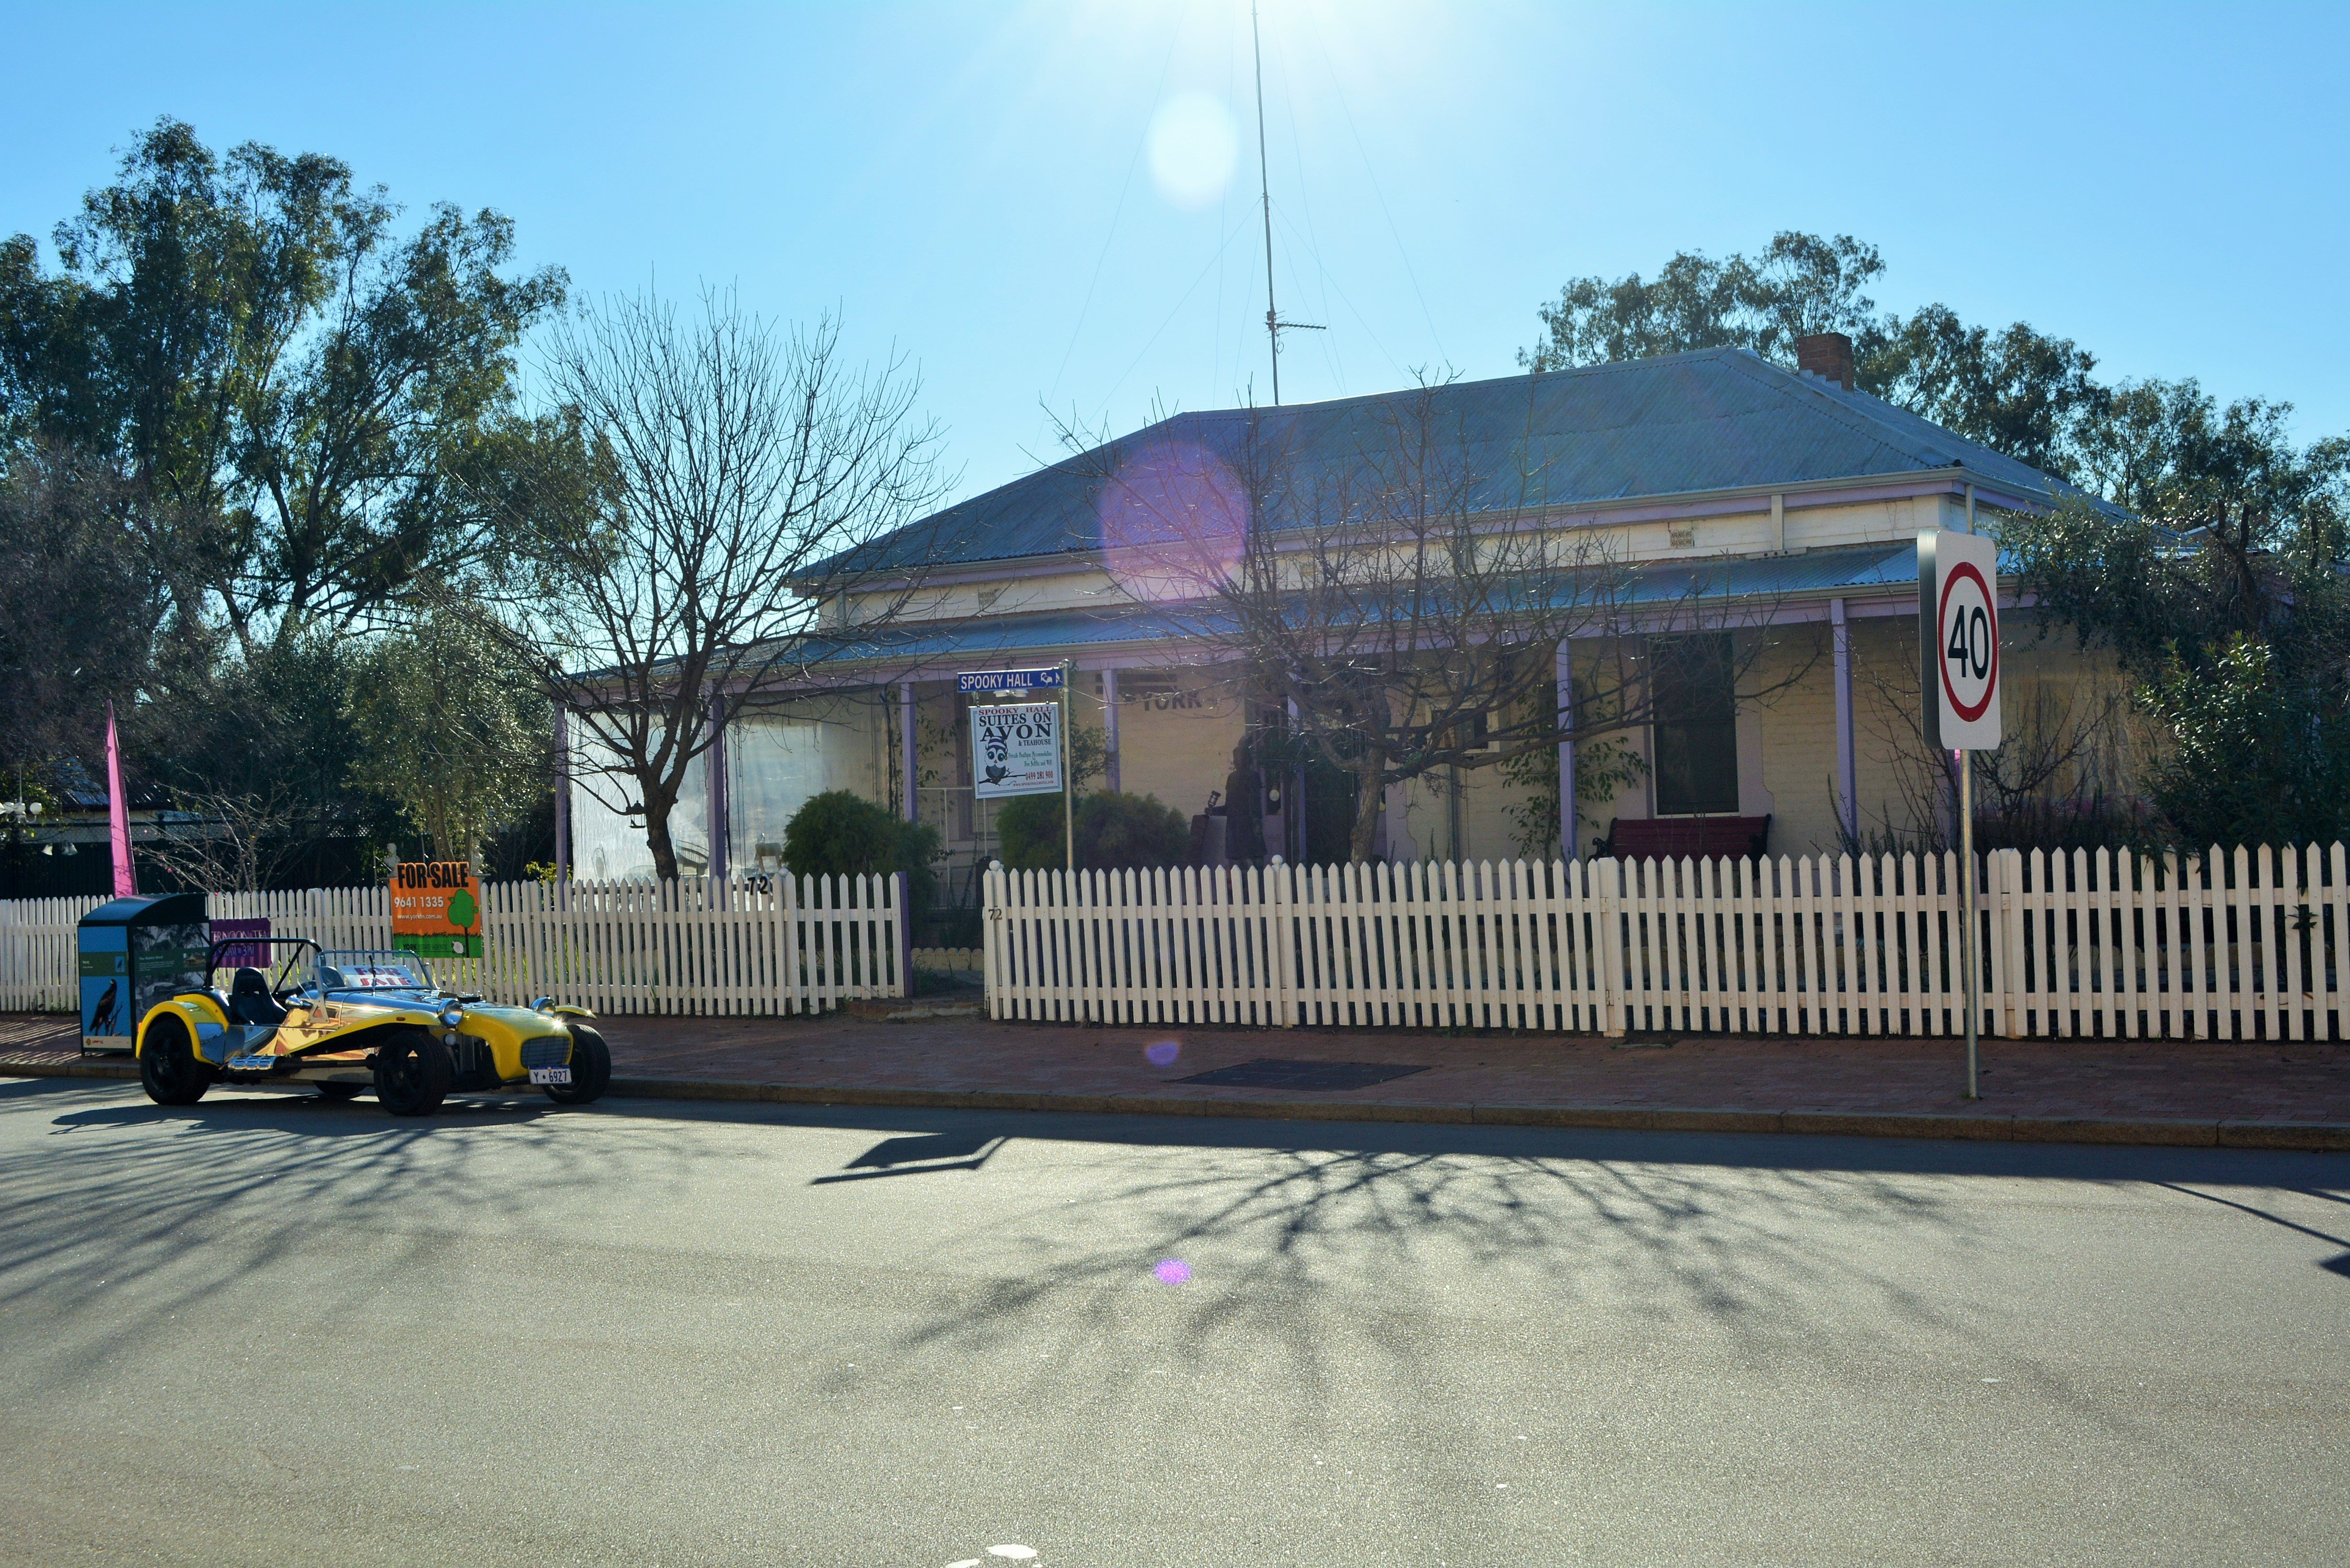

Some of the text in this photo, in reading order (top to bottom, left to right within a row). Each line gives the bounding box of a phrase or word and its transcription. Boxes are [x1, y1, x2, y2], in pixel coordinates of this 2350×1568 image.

[1948, 605, 1989, 679] 40
[961, 673, 1033, 689] SPOOKY HALL
[979, 712, 1051, 727] SUITES ON
[980, 723, 1052, 742] AVON
[397, 862, 469, 889] FOR SALE
[747, 876, 768, 895] 72
[394, 896, 444, 908] 9641 1335
[988, 908, 1003, 920] 72
[354, 967, 402, 976] FOR
[360, 977, 414, 986] SALE
